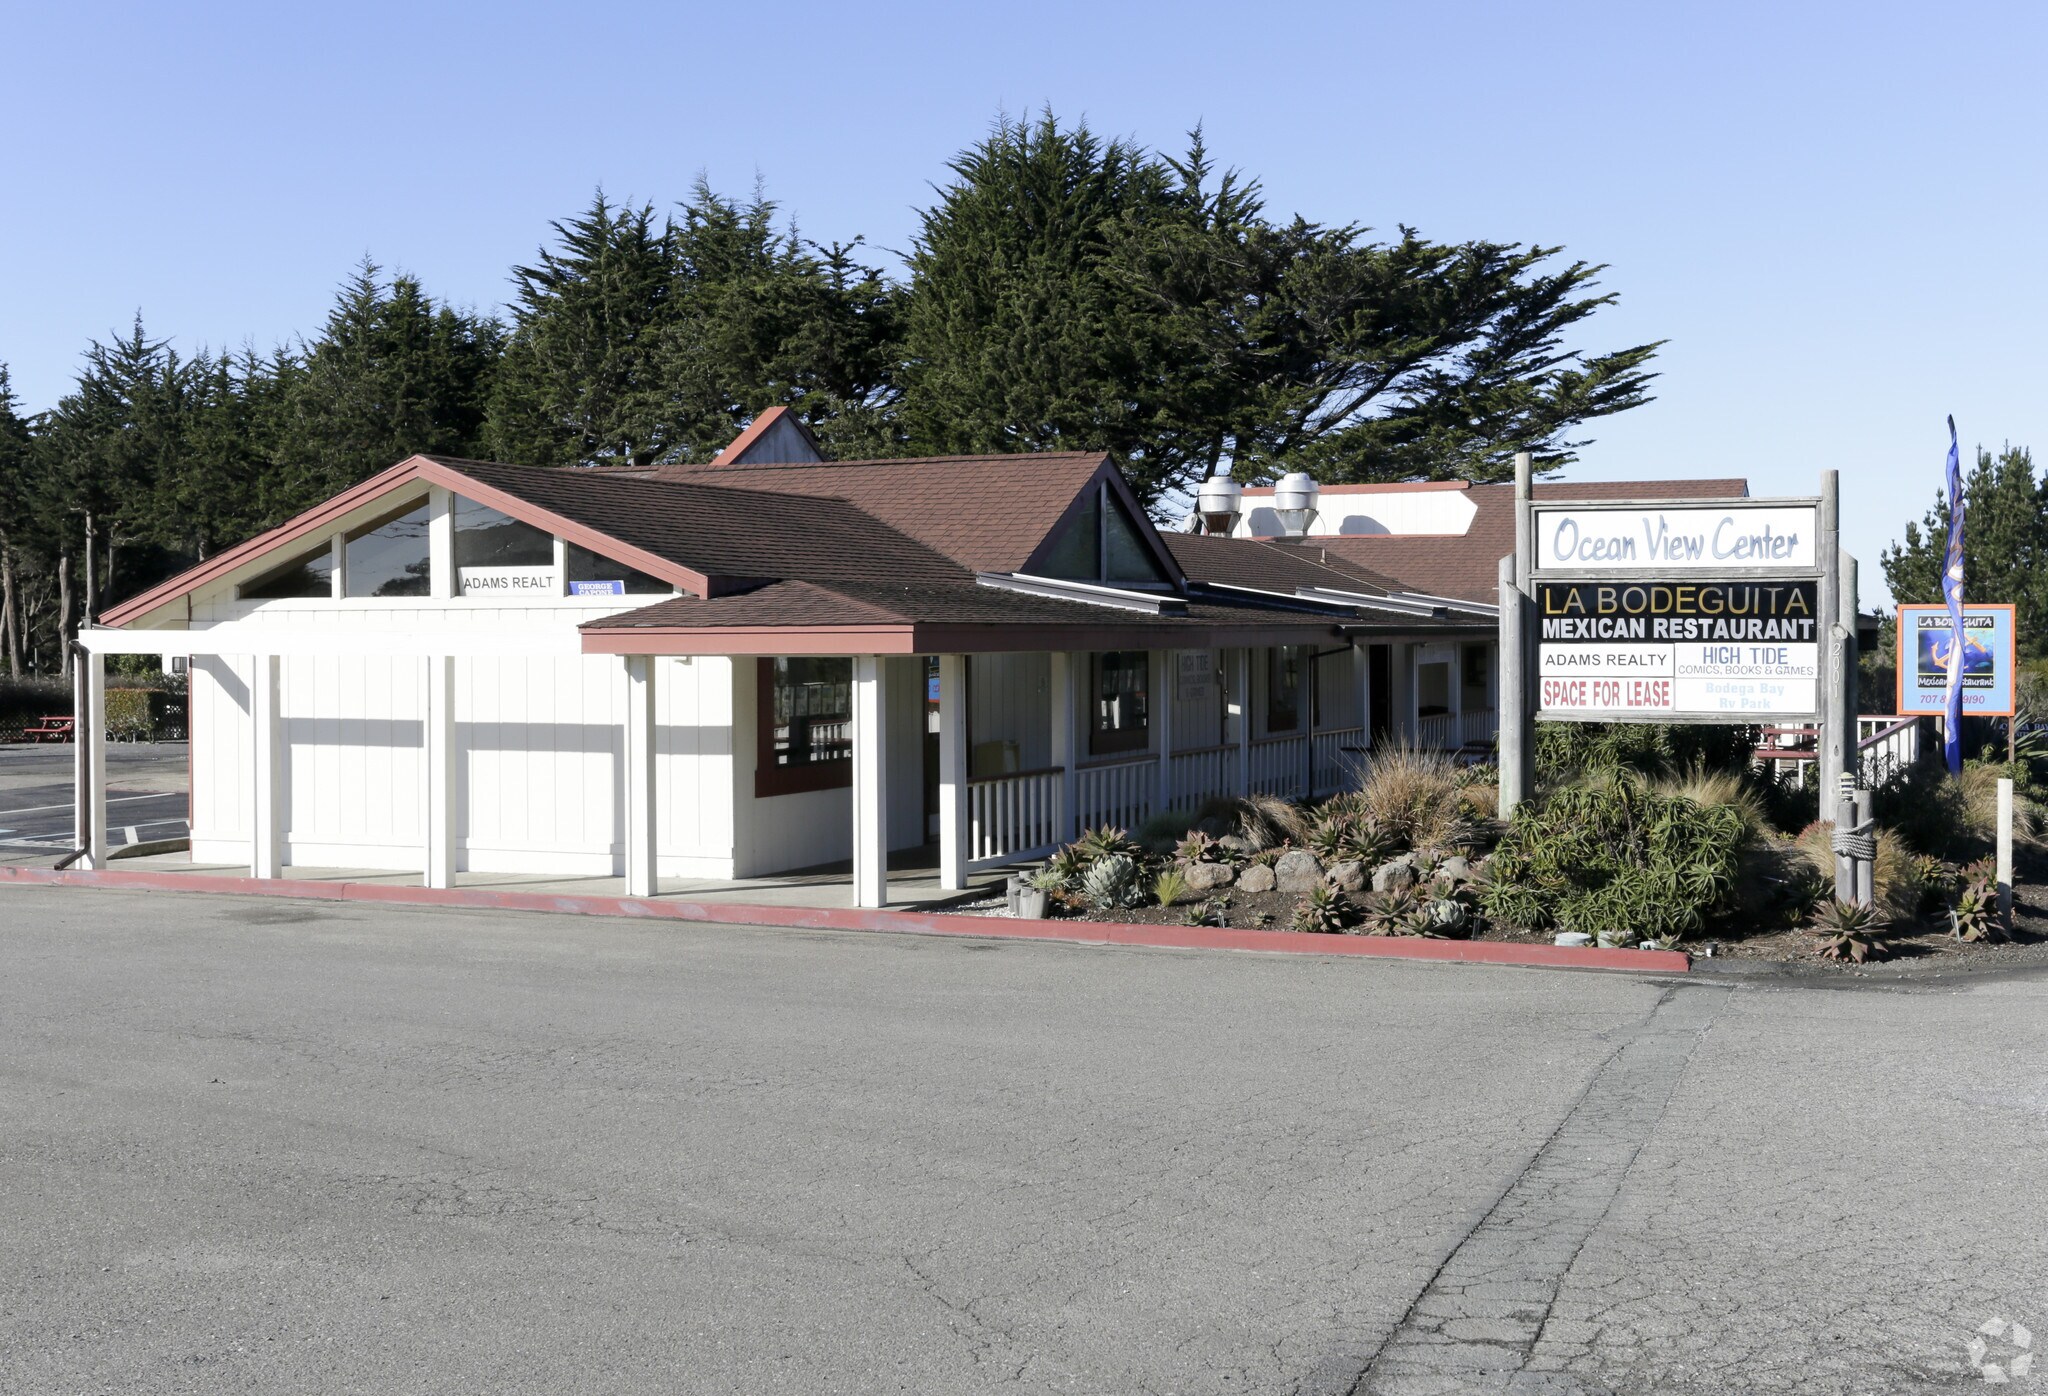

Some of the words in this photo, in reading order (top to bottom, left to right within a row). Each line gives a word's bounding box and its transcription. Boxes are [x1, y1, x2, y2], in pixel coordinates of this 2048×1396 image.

[1554, 517, 1635, 561] Ocean
[1643, 515, 1704, 560] View
[1712, 517, 1799, 559] Center
[464, 578, 508, 589] ADAMS
[513, 576, 554, 588] REALT
[1545, 588, 1585, 614] LA
[1598, 587, 1808, 614] BODEGUITA
[1919, 618, 1932, 626] LA
[1935, 617, 1992, 626] BODGUITA
[1543, 618, 1646, 639] MEXICAN
[1654, 618, 1813, 640] RESTAURANT
[1545, 654, 1600, 666] ADAMS
[1607, 654, 1666, 666] REALTY
[1703, 647, 1740, 665] HIGH
[1749, 648, 1788, 665] TIDE
[1679, 665, 1722, 675] COMICS,
[1725, 666, 1761, 674] BOOKS
[1764, 666, 1772, 675] &
[1773, 665, 1813, 675] GAMES
[1831, 643, 1841, 698] 2001
[1544, 681, 1586, 706] SPACE
[1593, 681, 1620, 706] FOR
[1627, 681, 1670, 706] LEASE
[1706, 683, 1754, 696] Bodega
[1760, 684, 1784, 696] Bay
[1720, 698, 1736, 708] Rv
[1741, 698, 1771, 709] Park
[1920, 695, 1936, 703] 707
